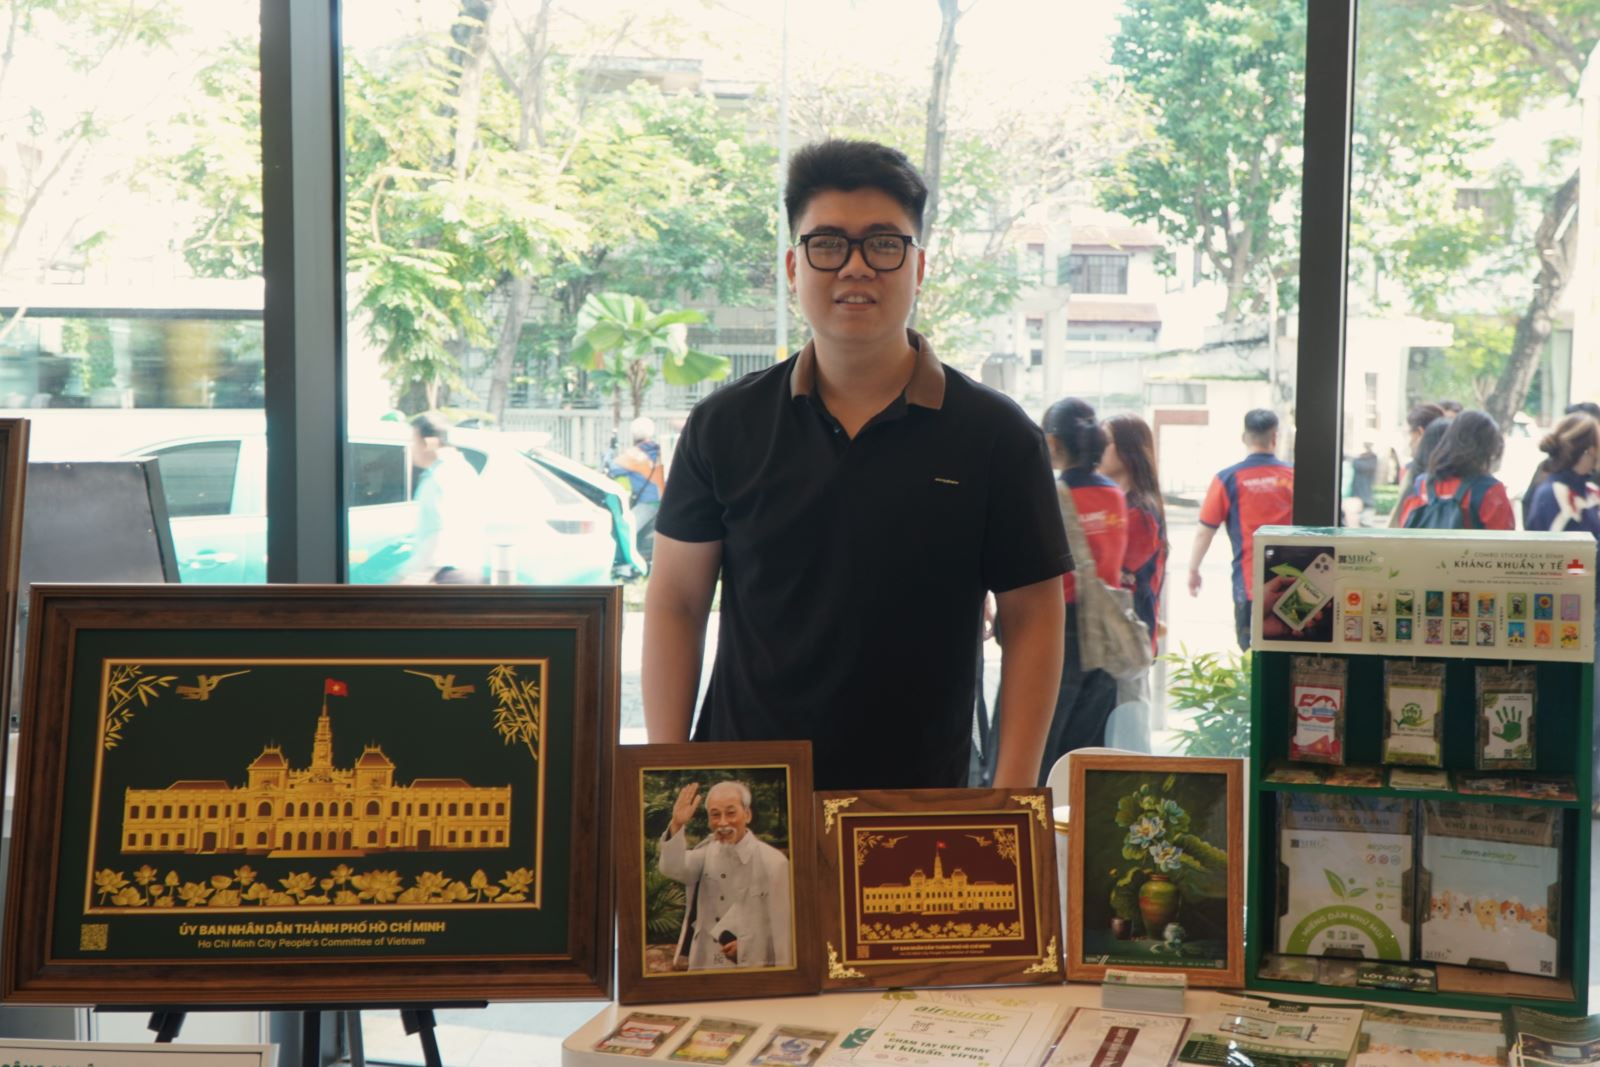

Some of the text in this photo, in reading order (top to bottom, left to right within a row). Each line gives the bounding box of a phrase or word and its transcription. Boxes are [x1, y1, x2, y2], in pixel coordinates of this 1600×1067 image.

[1454, 559, 1493, 569] KHÁNG
[1539, 561, 1546, 570] Y
[199, 924, 226, 935] BAN
[227, 921, 265, 935] NHÂN
[265, 920, 293, 935] DÂN
[294, 920, 340, 934] THÀNH
[340, 919, 368, 933] PHỐ
[368, 919, 388, 933] HỒ
[389, 919, 412, 933] CHÍ
[413, 921, 446, 933] MINH
[198, 939, 211, 948] Ho
[213, 938, 230, 948] Chi
[231, 938, 256, 948] Minh
[257, 938, 276, 949] City
[320, 937, 373, 947] Committee
[374, 936, 385, 946] of
[386, 936, 426, 946] Vietnam
